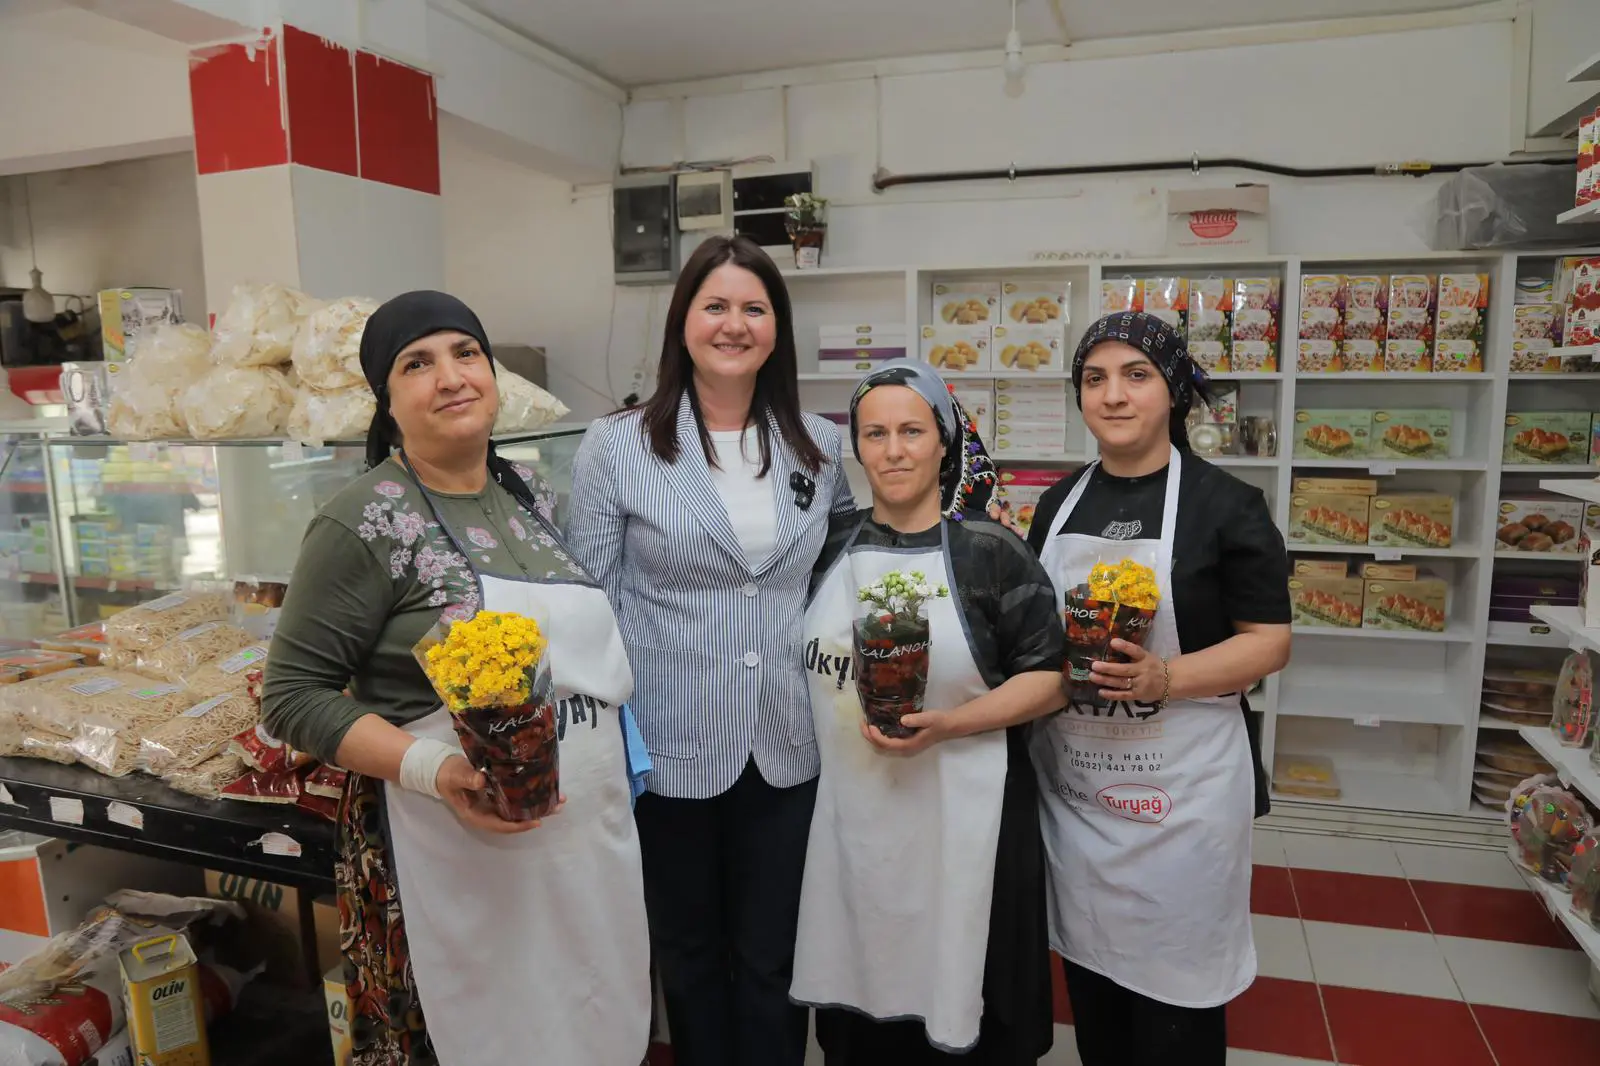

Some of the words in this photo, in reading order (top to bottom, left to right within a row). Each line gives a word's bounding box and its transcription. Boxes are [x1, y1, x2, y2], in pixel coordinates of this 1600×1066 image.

[1063, 744, 1113, 761] Sipariş
[1123, 752, 1163, 761] Hattı
[1070, 758, 1101, 772] (0532)
[1106, 764, 1126, 772] 441
[1131, 764, 1144, 772] 78
[1148, 763, 1161, 771] 02
[1102, 795, 1163, 815] Turyağ
